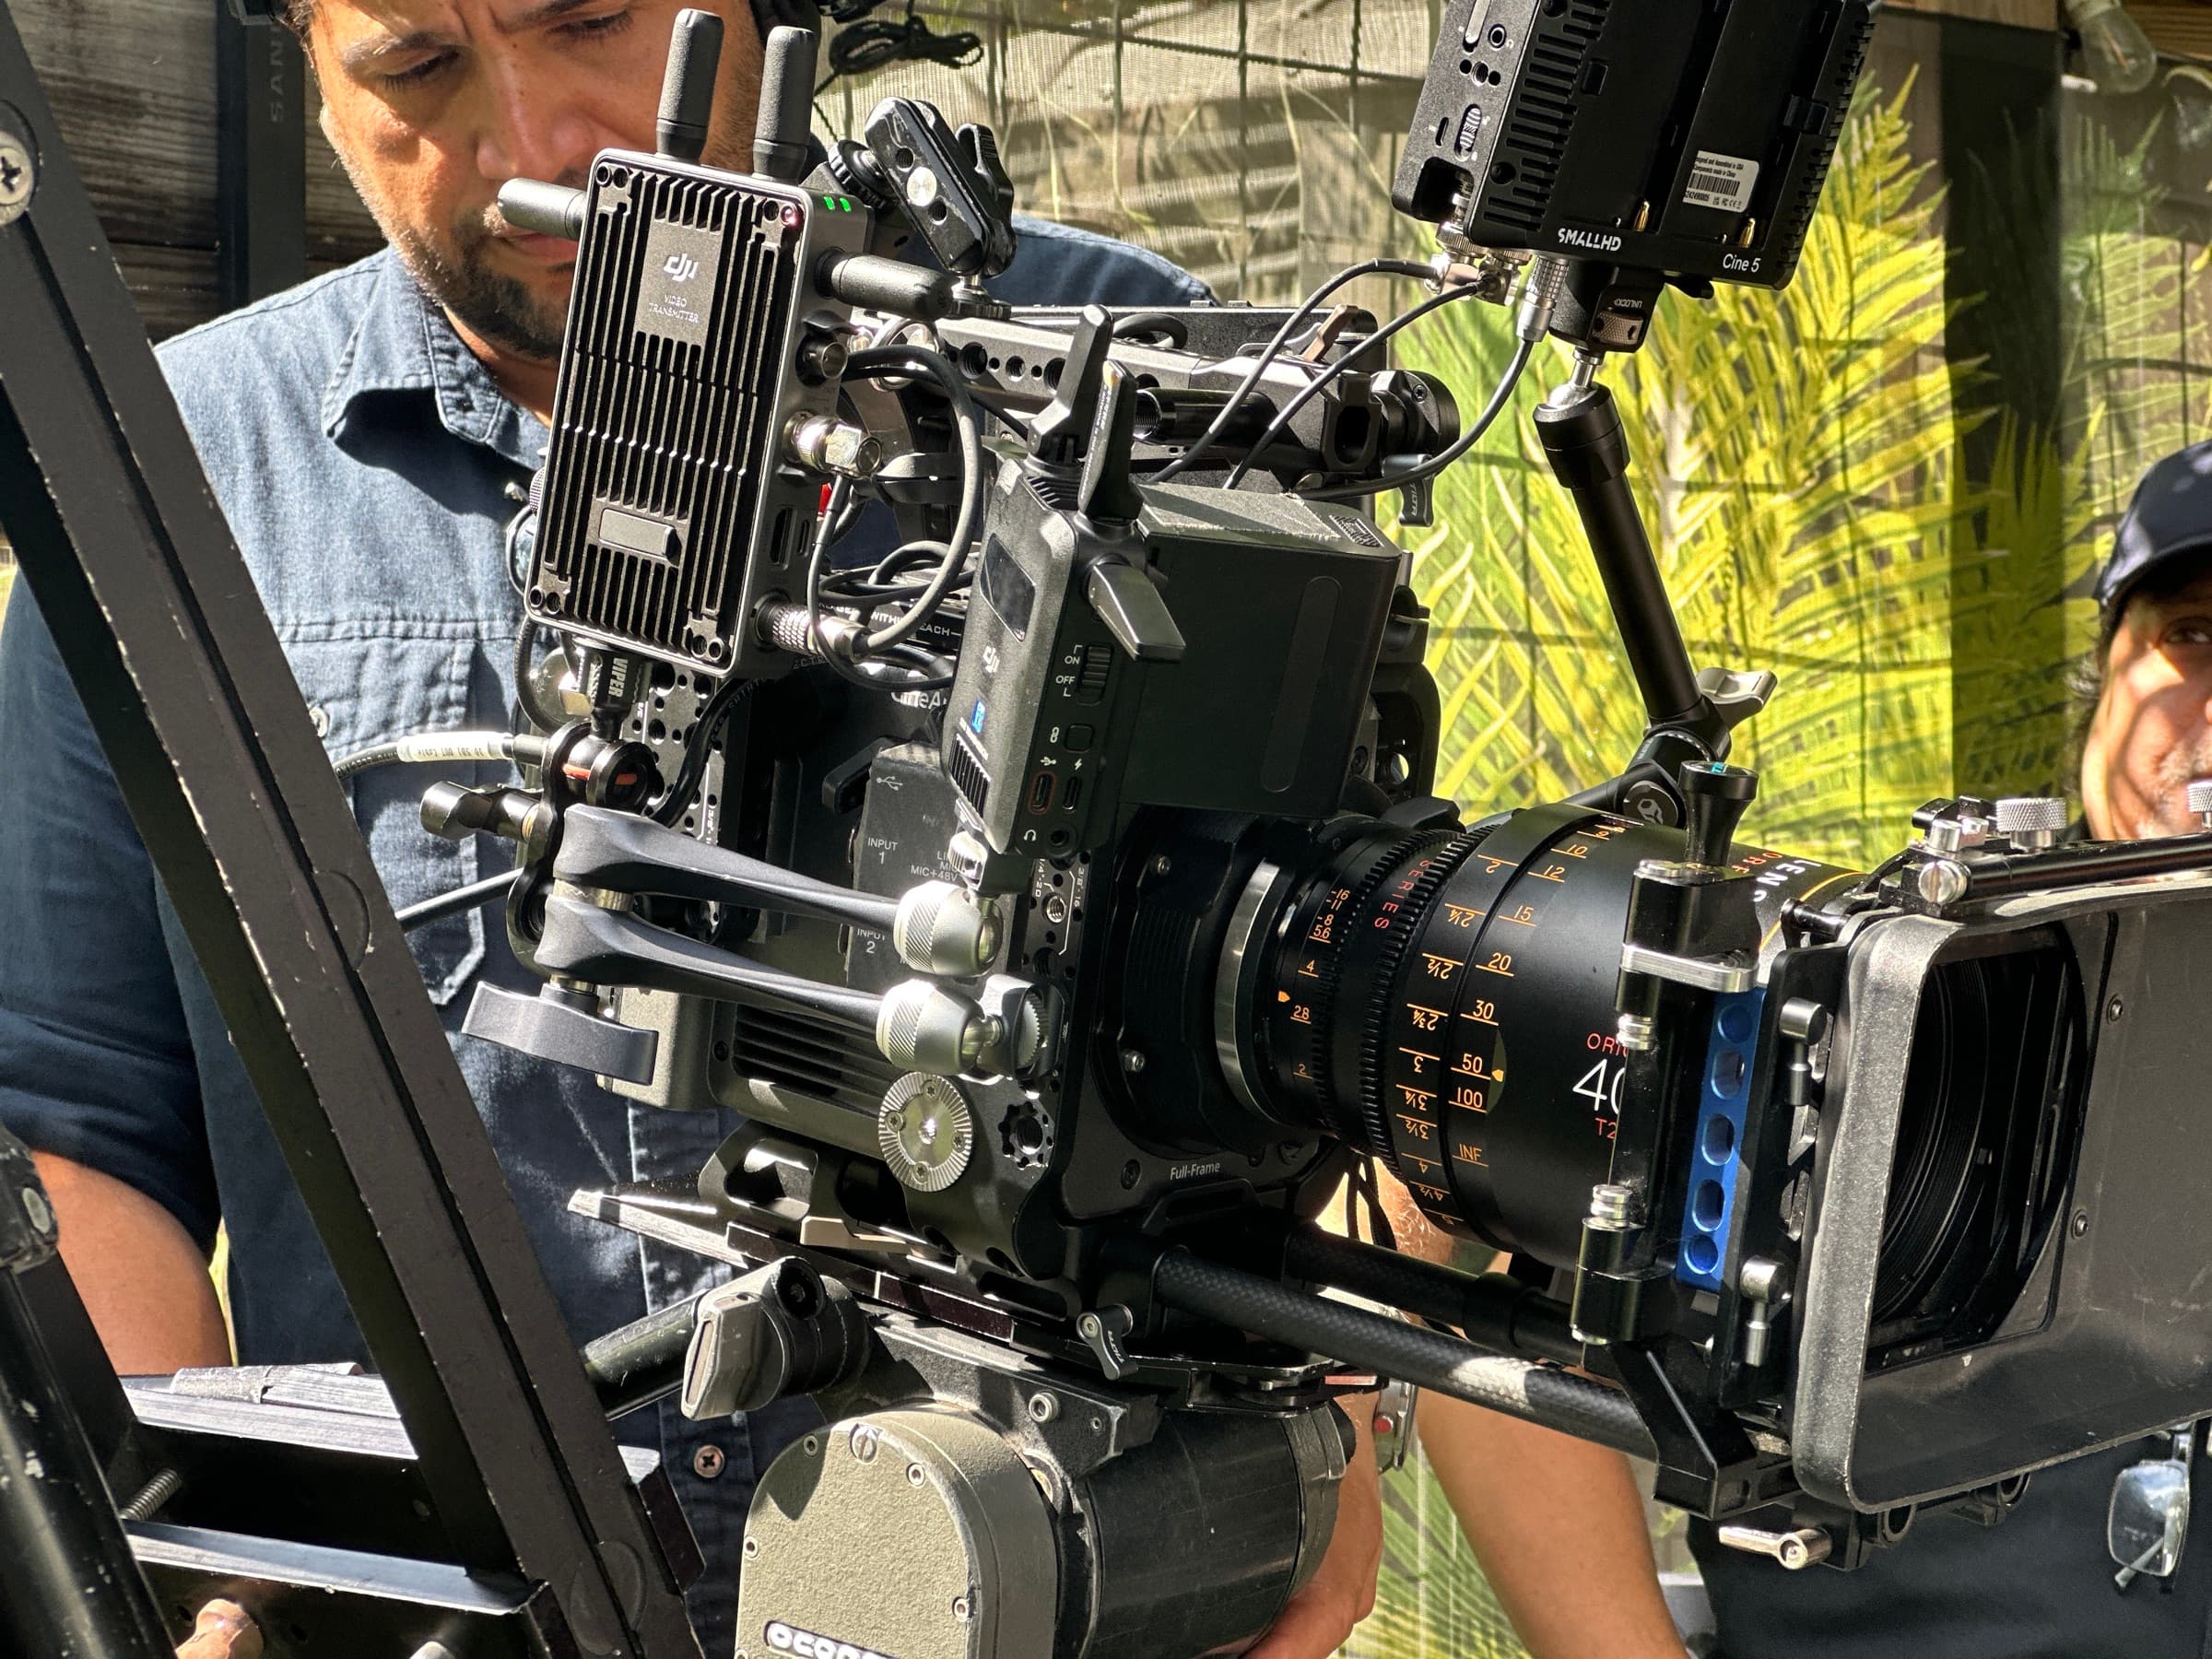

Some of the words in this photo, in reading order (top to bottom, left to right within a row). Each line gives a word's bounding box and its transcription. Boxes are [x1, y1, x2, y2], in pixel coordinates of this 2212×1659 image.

[1558, 228, 1622, 252] SMALLHD
[1723, 253, 1749, 271] Cine
[1750, 257, 1761, 273] 5
[665, 295, 688, 308] VIDEO
[649, 302, 700, 324] TRANSMITTER
[1065, 655, 1080, 665] ON
[608, 657, 628, 698] VIPER
[1055, 676, 1076, 686] OFF
[867, 837, 899, 852] INPUT
[1566, 844, 1588, 855] 10
[878, 851, 886, 865] 1
[911, 864, 959, 882] MIC+48V
[1486, 861, 1501, 874] 2
[1544, 865, 1566, 878] 12
[1513, 905, 1535, 922] 15
[1313, 924, 1332, 939] 5.6
[866, 941, 876, 954] 2
[1306, 959, 1315, 972] 4
[1488, 952, 1512, 971] 20
[1293, 1005, 1310, 1020] 2.8
[1473, 999, 1495, 1020] 30
[1298, 1063, 1306, 1075] 2
[1414, 1055, 1424, 1073] 3
[1462, 1053, 1483, 1074] 50
[1457, 1087, 1483, 1108] 100
[1459, 1143, 1483, 1161] INF
[1170, 1162, 1221, 1181] Full-Frame
[1418, 1160, 1429, 1174] 4
